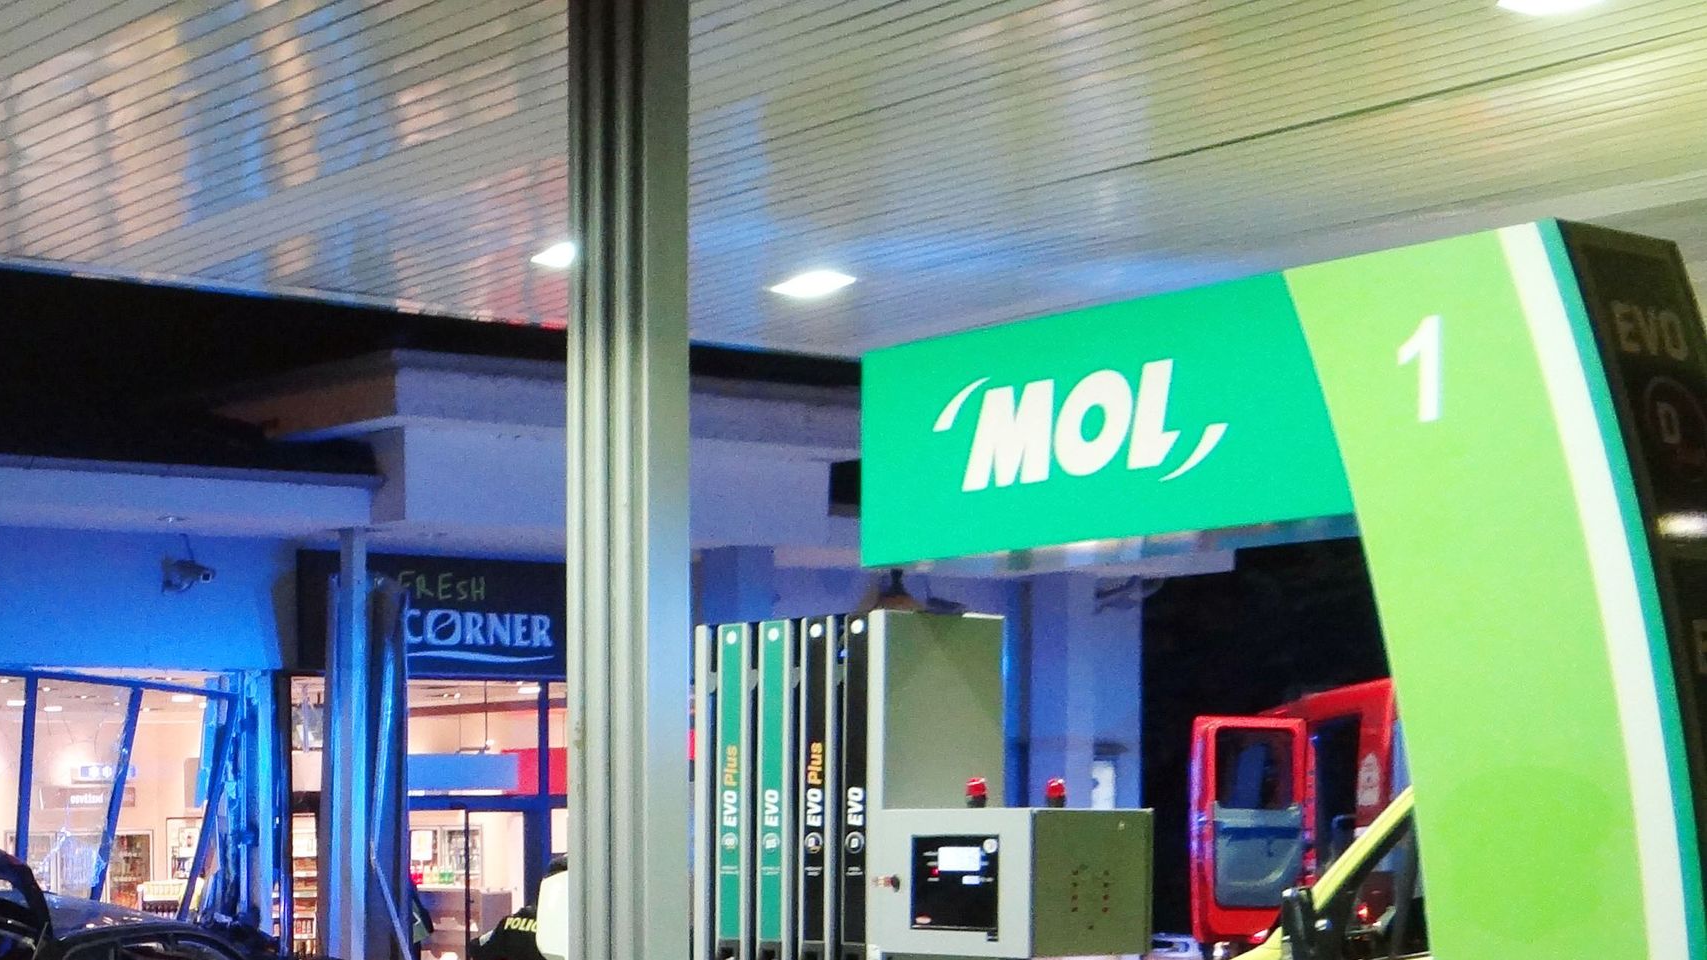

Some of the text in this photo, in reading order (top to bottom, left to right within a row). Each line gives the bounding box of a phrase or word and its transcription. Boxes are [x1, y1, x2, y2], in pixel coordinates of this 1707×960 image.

[1613, 302, 1688, 362] EVO
[1397, 314, 1443, 422] 1
[961, 358, 1181, 492] MOL
[405, 608, 553, 647] CORNER
[723, 744, 738, 786] Plus
[807, 741, 823, 785] Plus
[723, 790, 737, 827] EVO
[764, 789, 779, 827] EVO
[806, 788, 822, 827] EVO
[847, 786, 864, 827] EVO
[503, 917, 537, 933] POLIC
